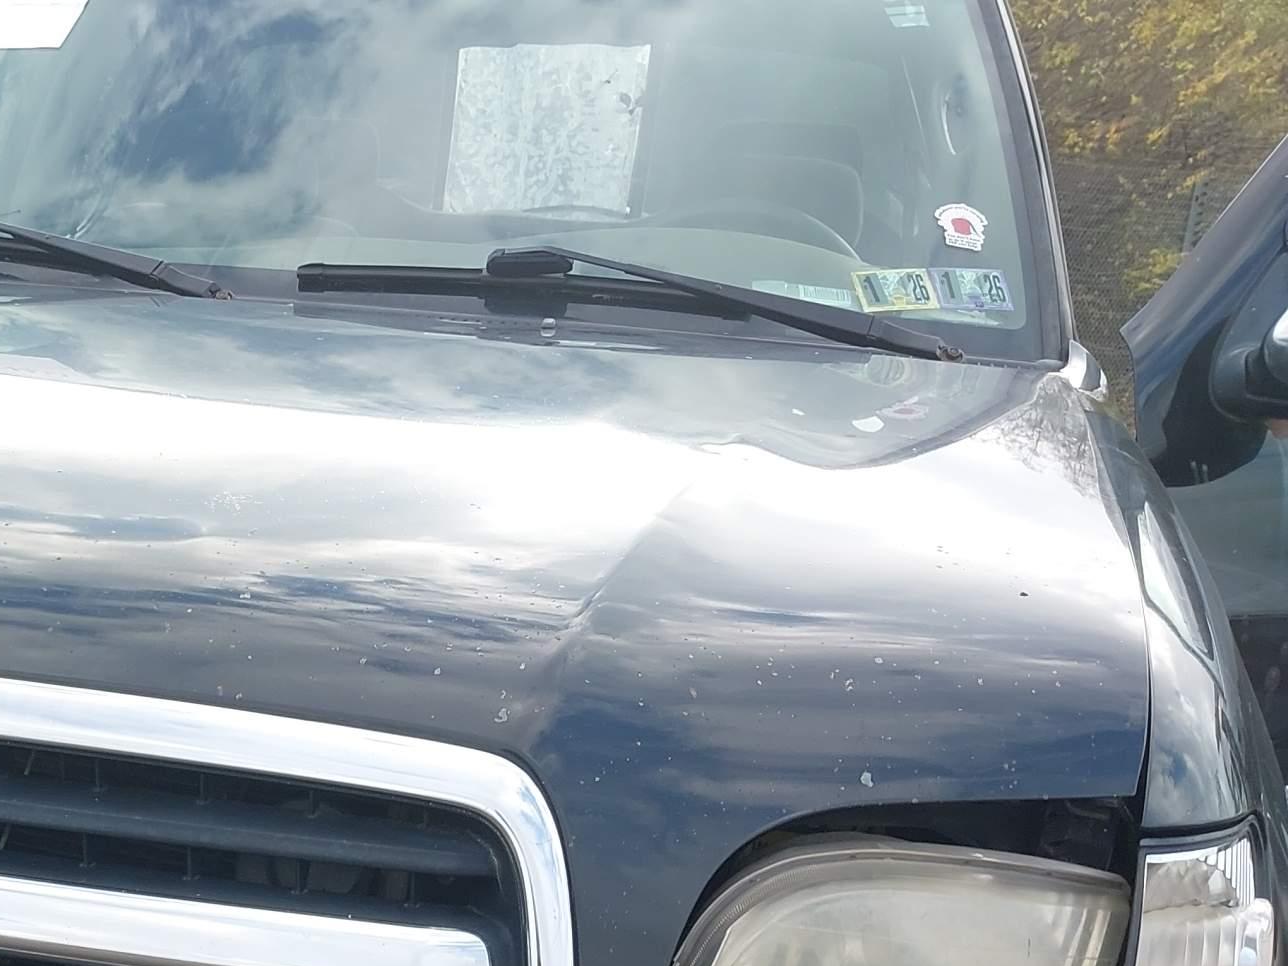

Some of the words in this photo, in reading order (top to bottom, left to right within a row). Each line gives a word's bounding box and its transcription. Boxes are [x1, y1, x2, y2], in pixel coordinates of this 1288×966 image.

[863, 276, 880, 303] 1
[907, 274, 930, 301] 26
[983, 274, 1007, 303] 26
